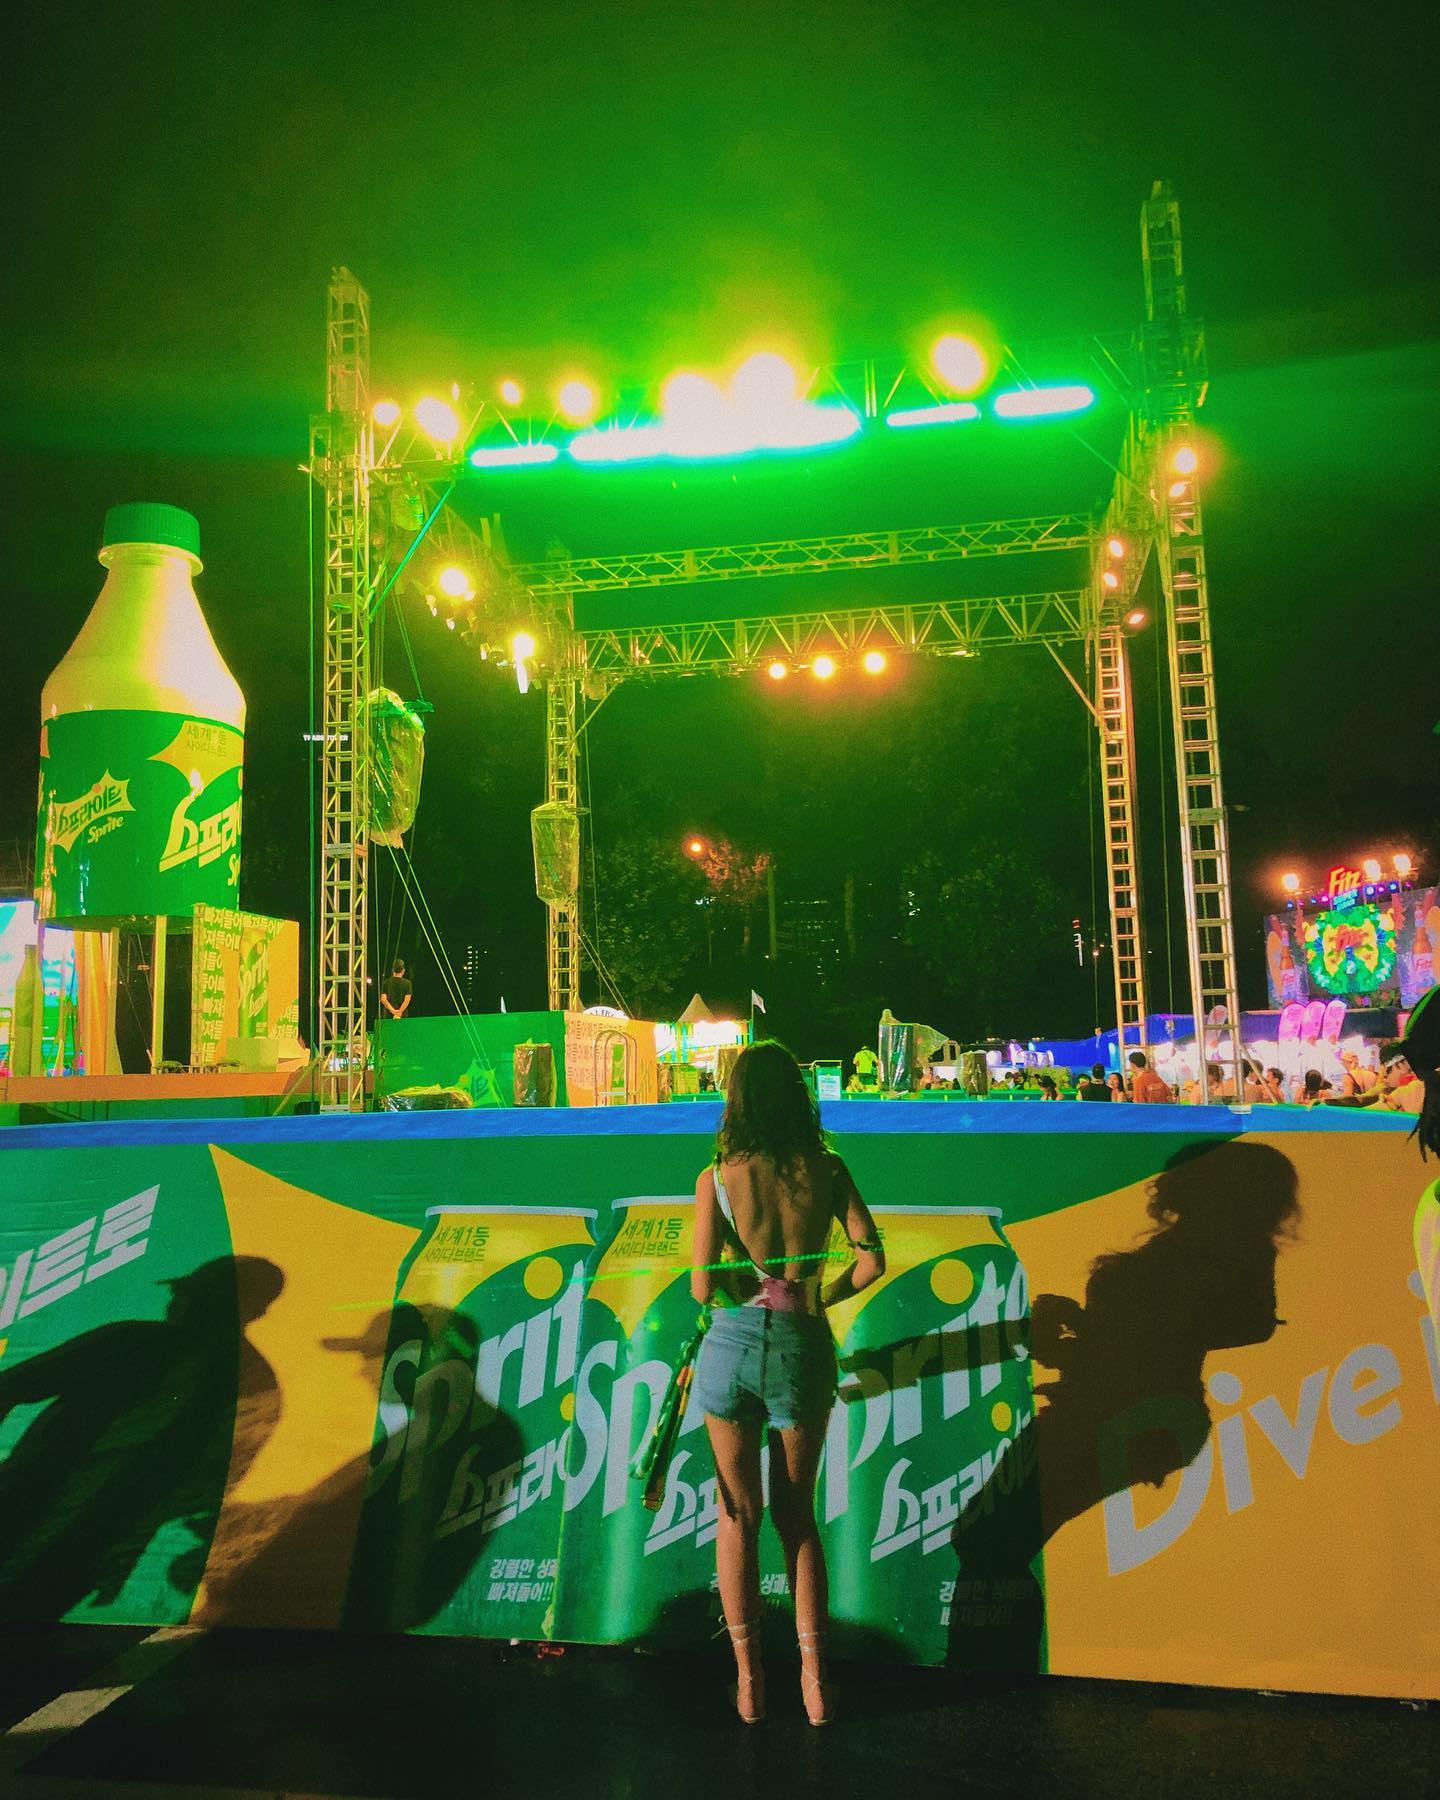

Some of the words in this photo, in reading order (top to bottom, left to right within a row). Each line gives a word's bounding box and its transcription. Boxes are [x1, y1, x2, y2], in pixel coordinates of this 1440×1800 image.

[57, 785, 122, 840] 스프라이트
[87, 815, 125, 844] Sprite
[159, 793, 243, 873] 스프라
[434, 1226, 490, 1247] 세계1등
[622, 1217, 684, 1239] 세계1등
[424, 1247, 486, 1262] 사이다브랜드
[612, 1241, 680, 1257] 사이다브랜드
[366, 1260, 585, 1505] Sprit
[1098, 1343, 1402, 1577] Dive
[490, 1558, 535, 1579] 강렬한
